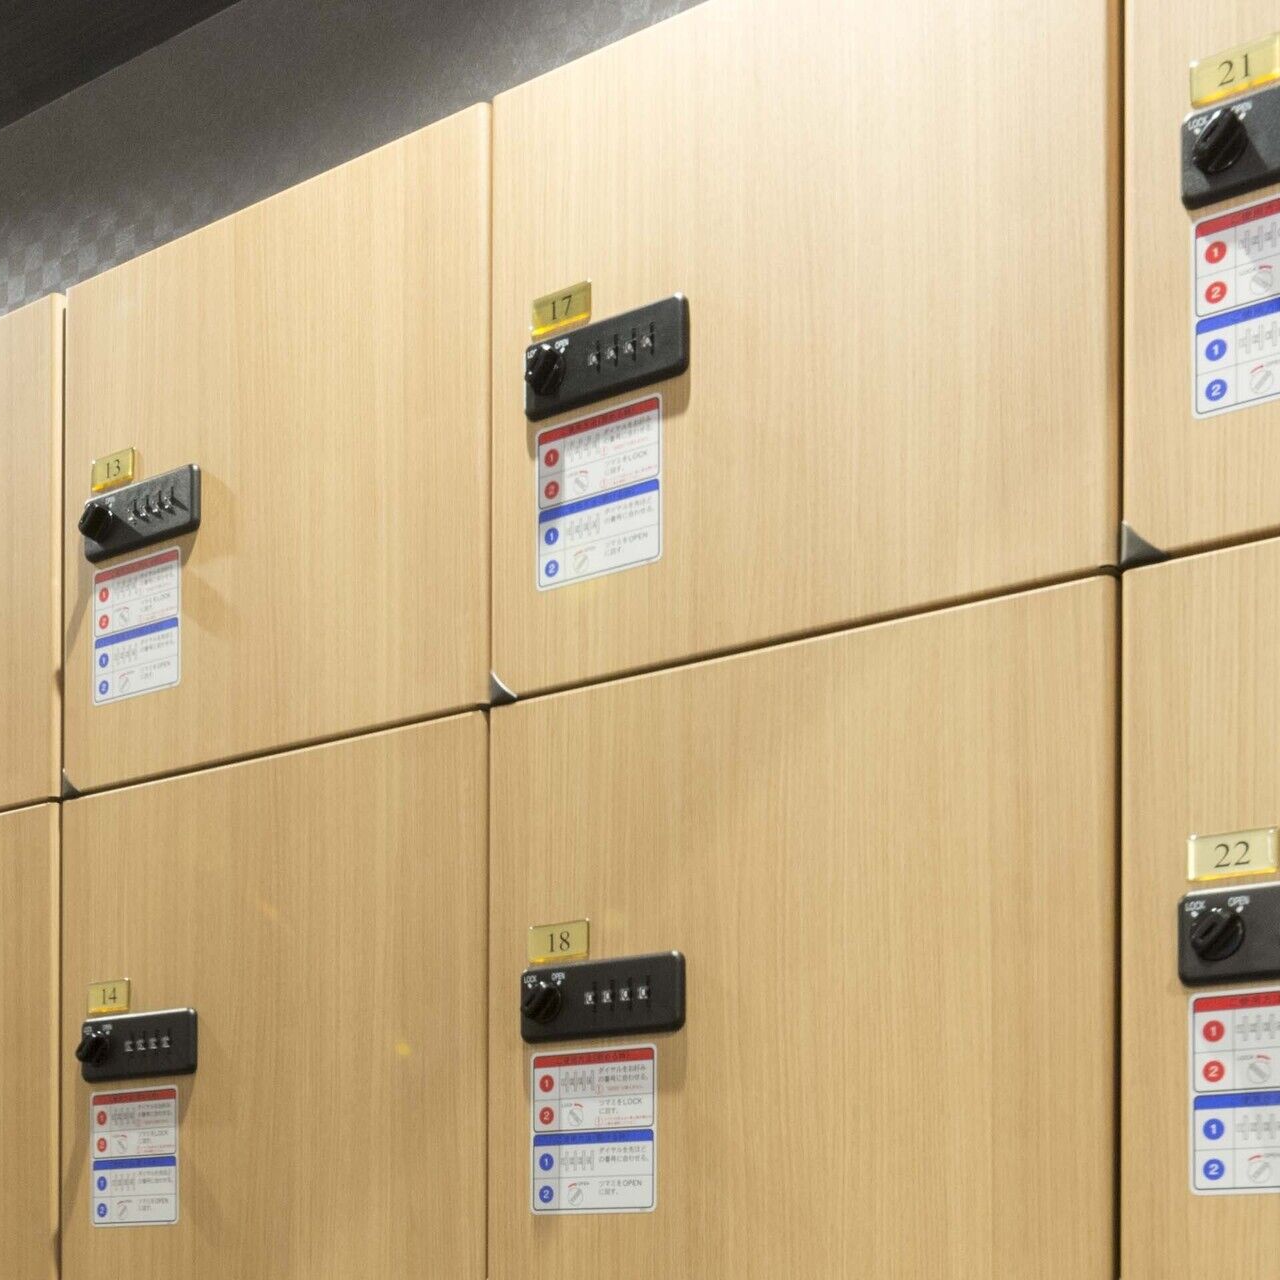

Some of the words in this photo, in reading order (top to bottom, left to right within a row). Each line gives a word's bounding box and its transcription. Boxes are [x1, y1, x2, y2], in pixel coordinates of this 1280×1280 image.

[1218, 53, 1251, 87] 21
[551, 295, 573, 321] 17
[106, 459, 121, 480] 13
[1214, 841, 1251, 869] 22
[1185, 899, 1207, 912] LOCK
[1228, 895, 1250, 907] OPEN
[547, 931, 571, 953] 18
[523, 975, 537, 984] LOCK
[551, 972, 565, 981] OPEN
[101, 987, 118, 1004] 14
